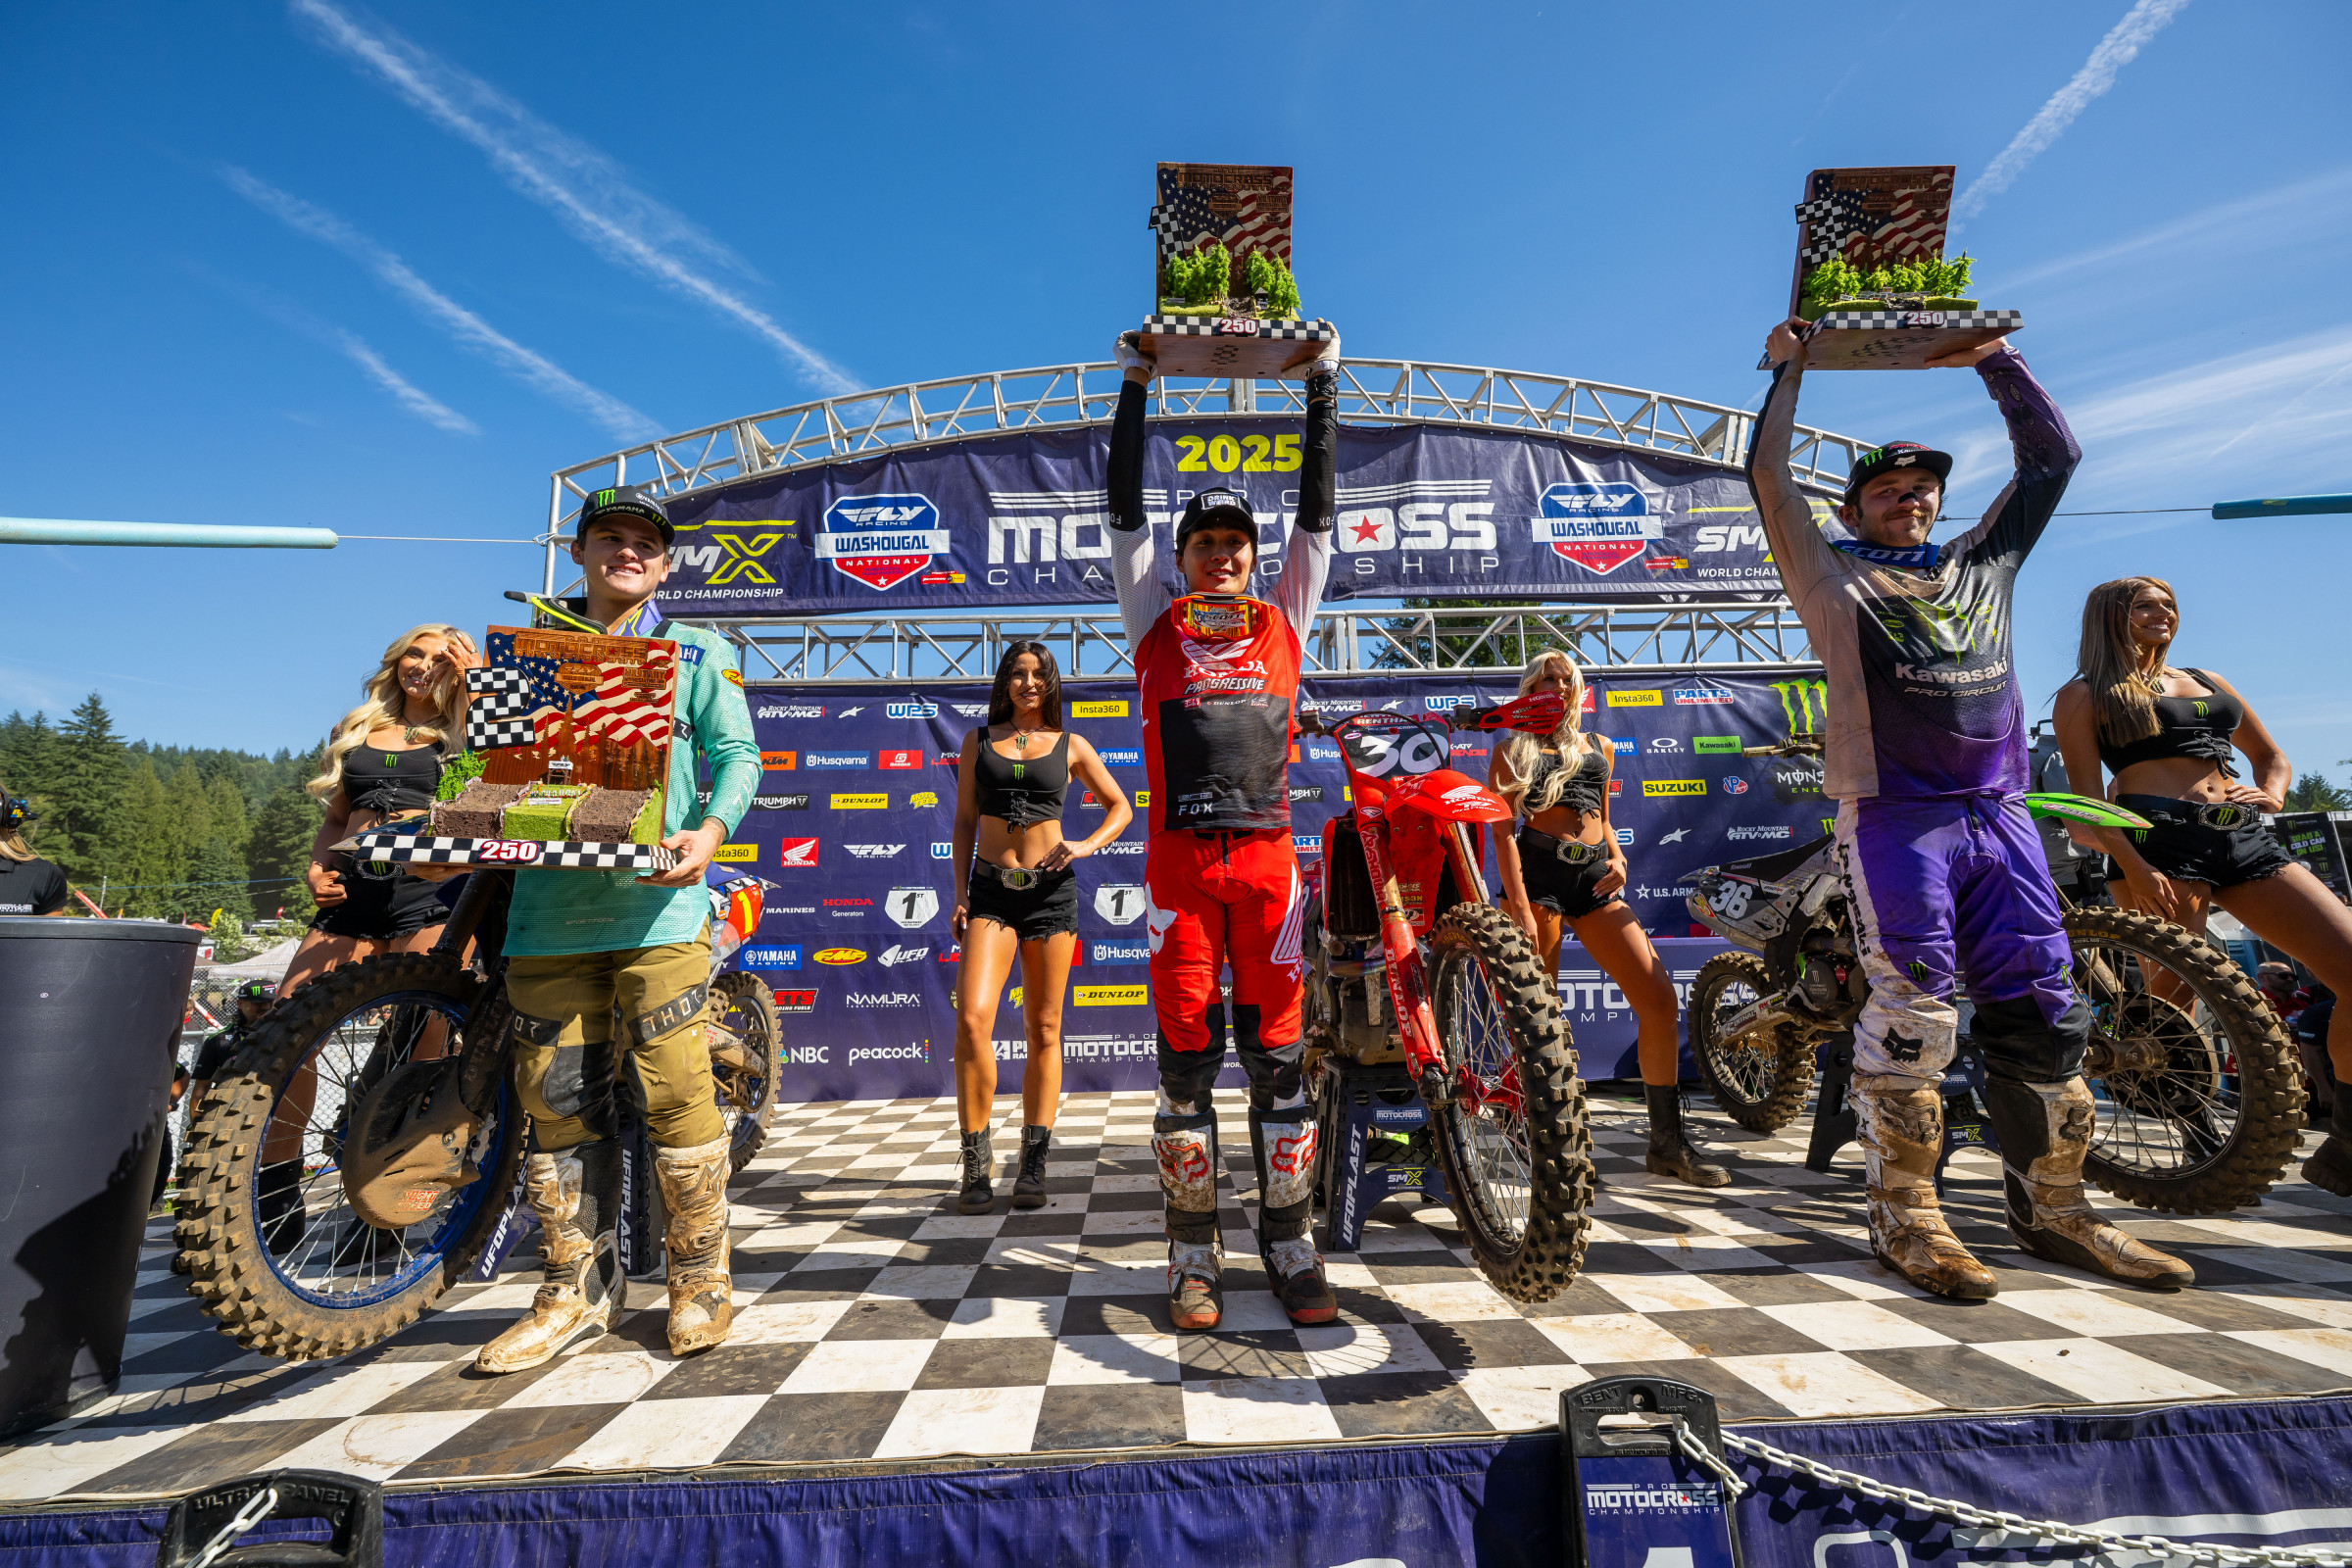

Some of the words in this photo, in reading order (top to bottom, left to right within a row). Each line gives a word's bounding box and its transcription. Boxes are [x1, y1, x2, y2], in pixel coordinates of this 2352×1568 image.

[1906, 311, 1945, 325] 250
[1220, 318, 1256, 333] 250
[1175, 434, 1303, 472] 2025
[1548, 493, 1637, 509] FLY
[606, 505, 645, 514] YAMAHA
[836, 506, 927, 523] FLY
[1109, 513, 1122, 525] FO
[988, 502, 1497, 564] MOOSS
[1550, 520, 1643, 537] WASHOUGAL
[834, 535, 930, 553] WASHOUGAL
[845, 558, 920, 567] NATIONAL
[987, 556, 1499, 585] CHAOSHIP
[1697, 567, 1741, 579] WORLD
[653, 590, 682, 600] ORLD
[684, 588, 784, 600] CHAMPIONSHIP
[1894, 657, 2008, 684] Kawasaki
[1183, 676, 1266, 696] PROGRESSIVE
[1904, 686, 1949, 697] PRO
[1951, 680, 2009, 697] CIRCUIT
[1614, 694, 1654, 703] Insta360
[1673, 689, 1732, 699] PARTS
[951, 704, 990, 714] FL
[1080, 705, 1120, 713] Insta360
[1425, 695, 1477, 711] WPS
[887, 703, 938, 719] WPS
[1613, 741, 1635, 750] MAHA
[761, 756, 789, 765] KTM
[816, 755, 867, 766] Husqvarna
[1107, 751, 1139, 760] YAMAHA
[1356, 732, 1449, 777] 30
[1644, 782, 1704, 794] SUZUKI
[1723, 776, 1740, 793] VP
[754, 795, 798, 809] TRIUMPH
[909, 792, 935, 804] MOTO
[913, 797, 939, 809] TEES
[1445, 794, 1497, 805] HONDA
[1178, 802, 1213, 816] FOX
[1292, 836, 1321, 846] ART
[2291, 832, 2313, 842] GRAB
[478, 841, 538, 860] 250
[844, 844, 906, 856] FLY
[2290, 840, 2309, 850] COLD
[2296, 847, 2308, 856] ON
[714, 849, 750, 858] sta360
[1653, 888, 1672, 898] U.S.
[1709, 880, 1753, 919] 36
[822, 898, 874, 906] HONDA
[737, 891, 754, 935] 1
[2067, 929, 2121, 940] UNLOP
[757, 950, 797, 961] YAMAHA
[814, 950, 867, 963] FMF
[896, 947, 929, 959] UFO
[1107, 948, 1151, 960] Husqva
[774, 991, 815, 1005] ETS
[847, 991, 919, 1004] NAMURA
[1384, 948, 1414, 1039] DUNLOP
[513, 1015, 541, 1039] OR
[791, 1047, 829, 1063] NBC
[849, 1042, 922, 1066] peacock
[1063, 1040, 1157, 1057] MOTOCR
[1951, 1127, 1984, 1142] SMX
[1343, 1123, 1362, 1245] UFOPLAST
[1388, 1170, 1423, 1186] SMX
[619, 1149, 632, 1271] UFOPLAST
[480, 1160, 529, 1278] UFOPLAS
[1580, 1384, 1623, 1407] BENT
[282, 1483, 350, 1505] PANEL
[1586, 1490, 1719, 1508] MOTOCROSS
[1588, 1506, 1720, 1515] CHAMPIONSHIP
